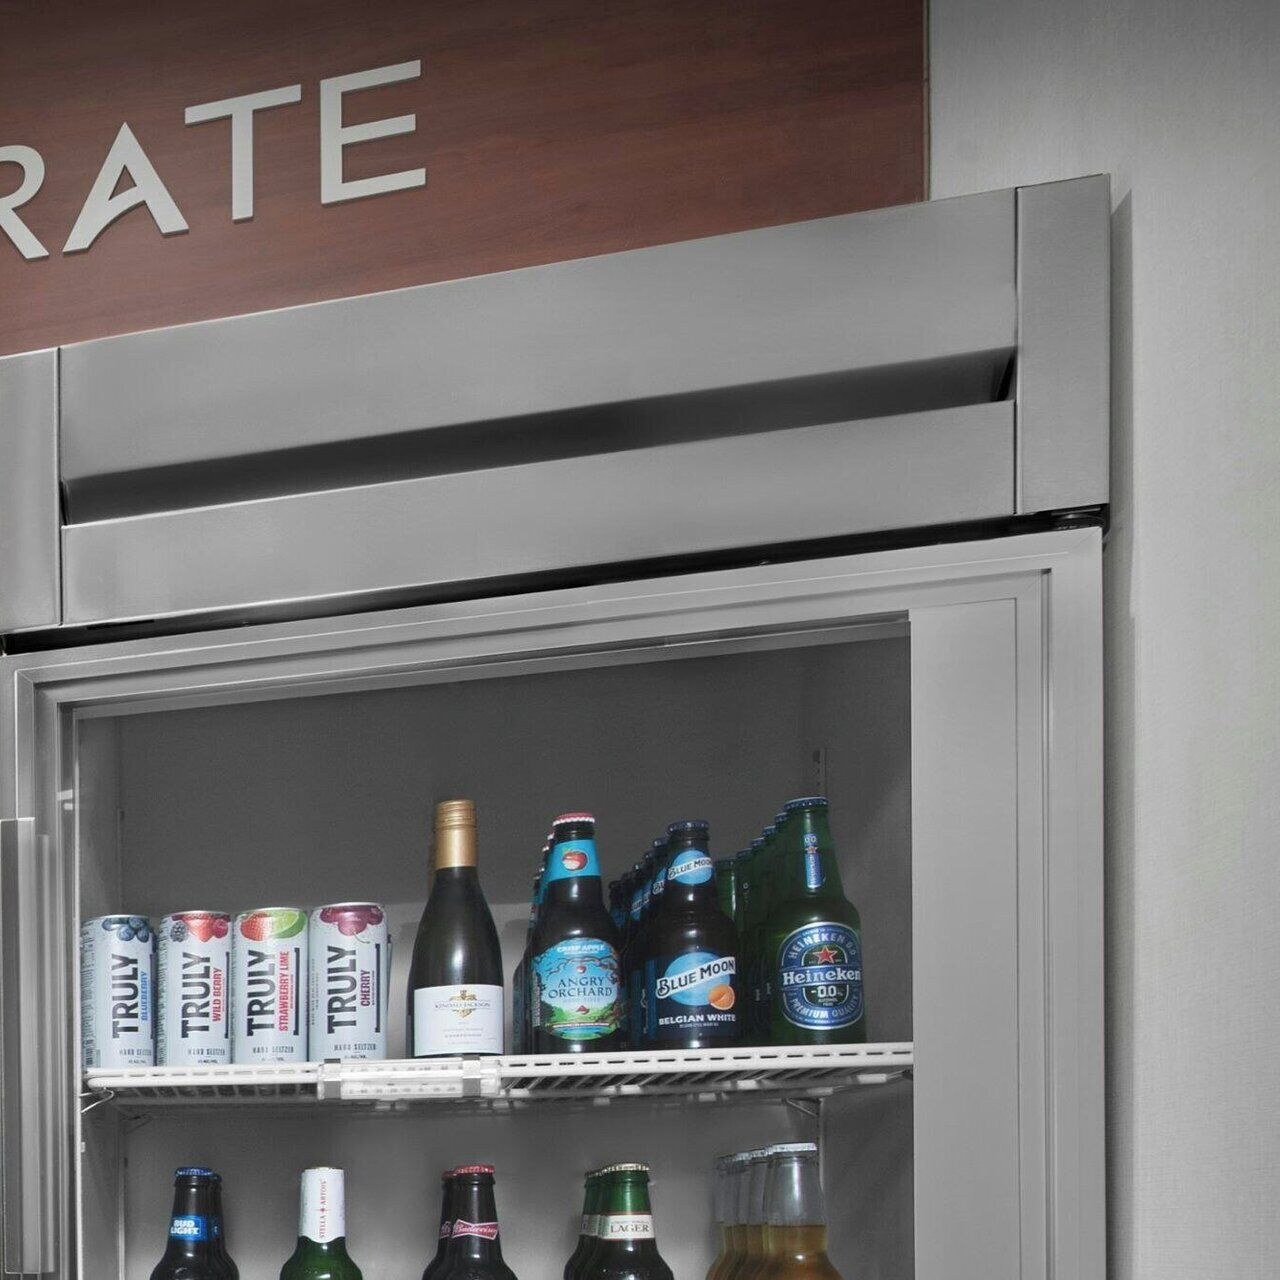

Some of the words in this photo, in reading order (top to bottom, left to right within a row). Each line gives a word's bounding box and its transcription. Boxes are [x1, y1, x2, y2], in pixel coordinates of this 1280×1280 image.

[668, 863, 692, 878] BLUE
[788, 933, 846, 958] HEINEKEN
[280, 951, 289, 976] LIME
[212, 967, 222, 996] BERRY
[360, 969, 370, 1006] CHERRY
[557, 976, 604, 988] ANGRY
[657, 971, 696, 997] BLUE
[700, 958, 735, 979] MOON
[783, 967, 860, 985] Heineken
[111, 953, 139, 1039] TRULY
[181, 952, 211, 1038] TRULY
[246, 949, 275, 1036] TRULY
[327, 945, 357, 1034] TRULY
[547, 986, 612, 998] ORCHARD
[212, 999, 221, 1022] WILD
[279, 977, 289, 1031] STRAWBERRY
[791, 998, 828, 1018] PREMIUM
[658, 1014, 705, 1025] BELGIAN
[707, 1014, 736, 1022] WHITE
[171, 1226, 200, 1235] LIGHT
[173, 1219, 196, 1228] BUD
[610, 1222, 649, 1233] LAGER
